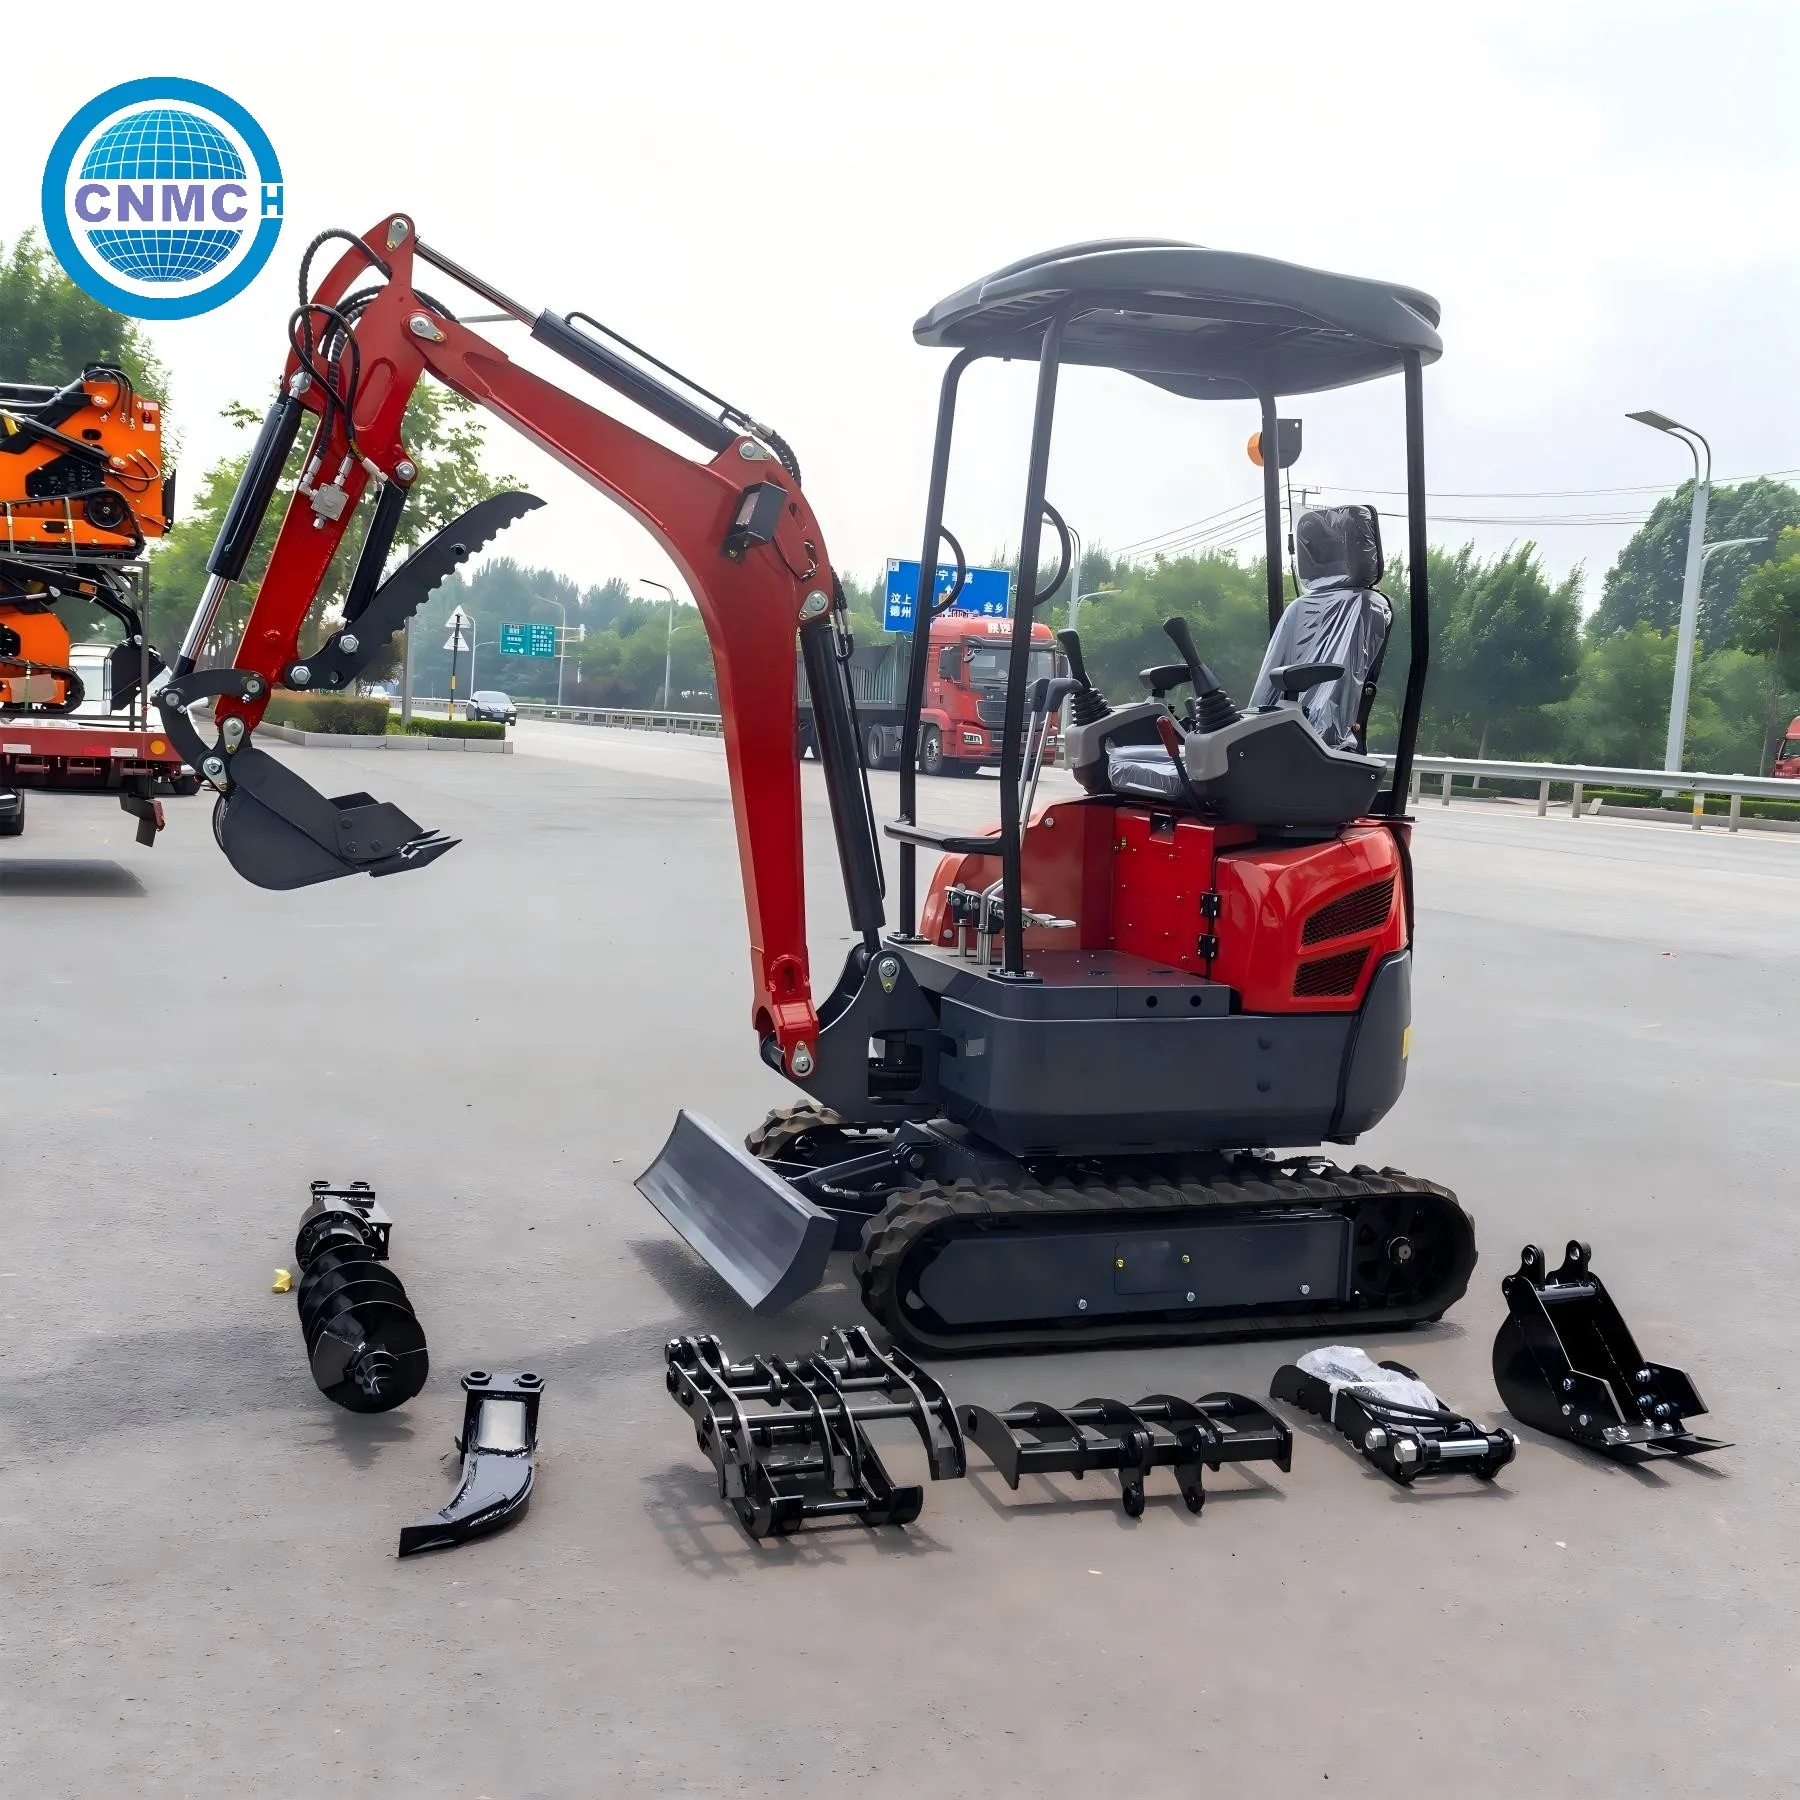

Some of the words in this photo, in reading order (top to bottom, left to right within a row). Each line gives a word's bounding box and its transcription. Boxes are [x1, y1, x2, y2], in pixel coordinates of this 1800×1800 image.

[890, 592, 912, 605] 汶上
[889, 605, 912, 619] 德州
[983, 601, 1004, 614] 金乡
